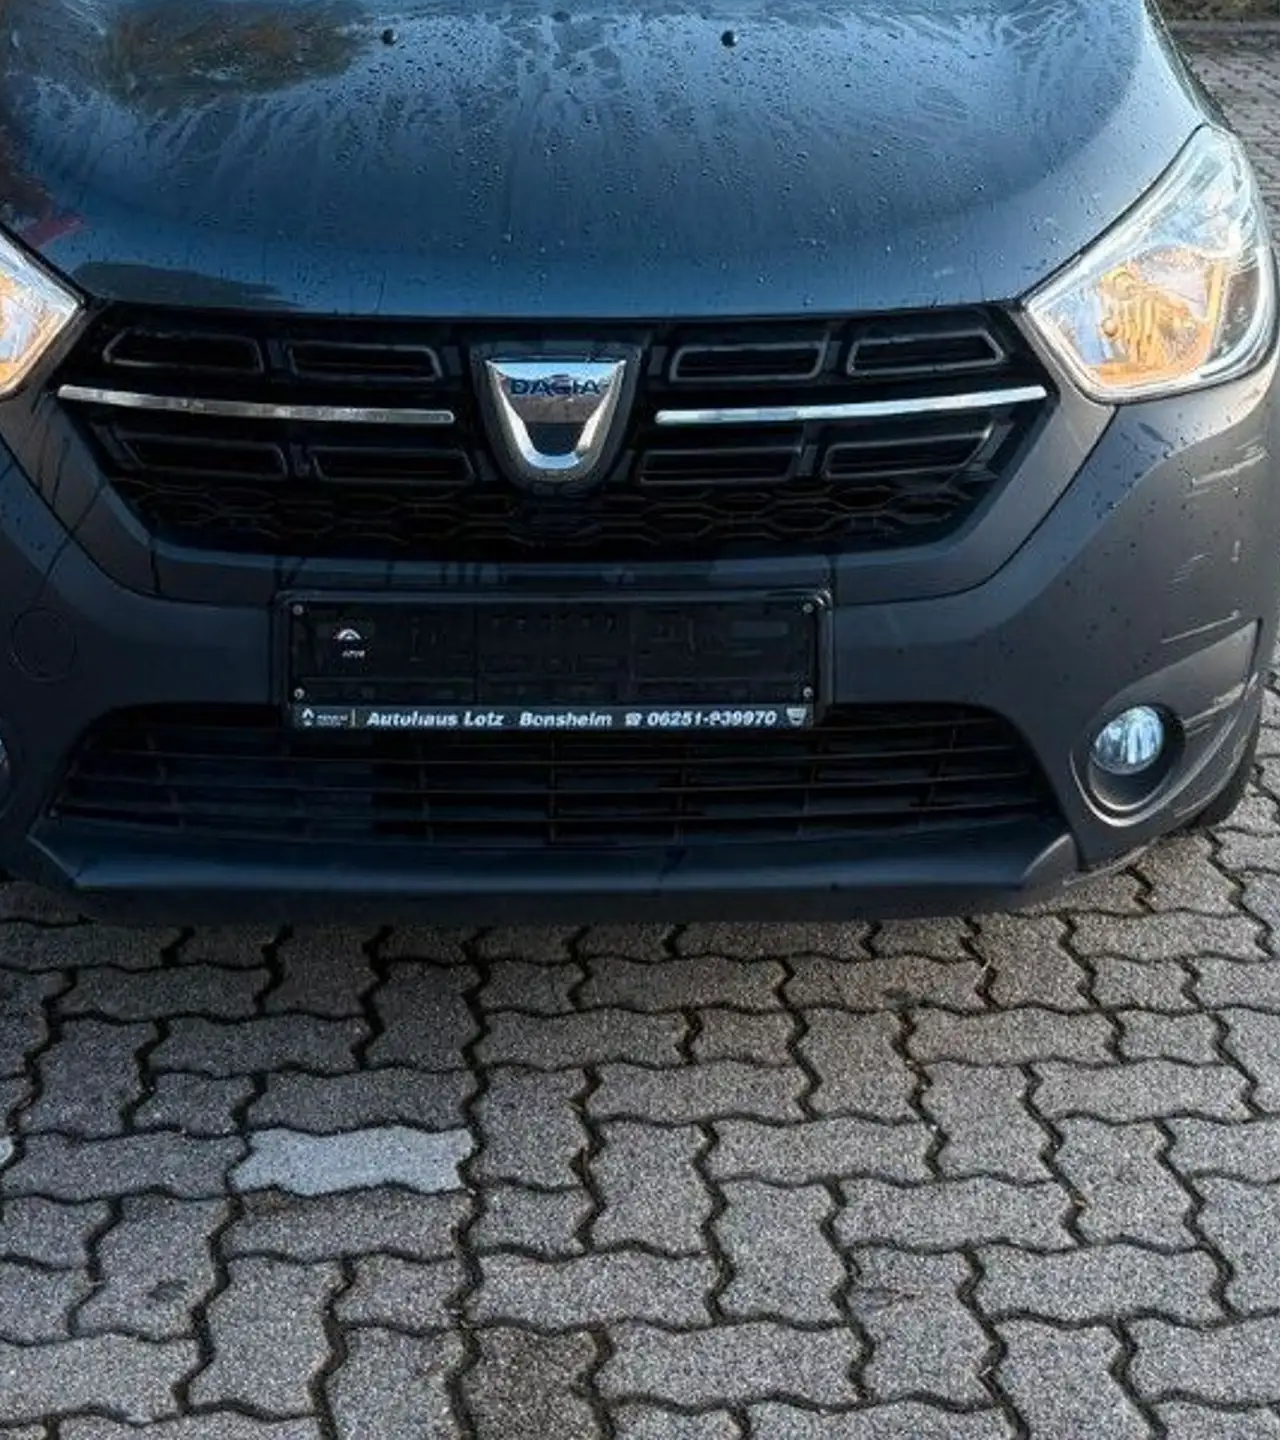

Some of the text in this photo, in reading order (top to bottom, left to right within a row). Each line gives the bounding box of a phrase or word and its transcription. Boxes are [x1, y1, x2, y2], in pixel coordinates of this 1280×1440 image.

[509, 377, 601, 396] DACIA
[366, 710, 459, 727] Autohaus
[463, 710, 505, 727] Lotz
